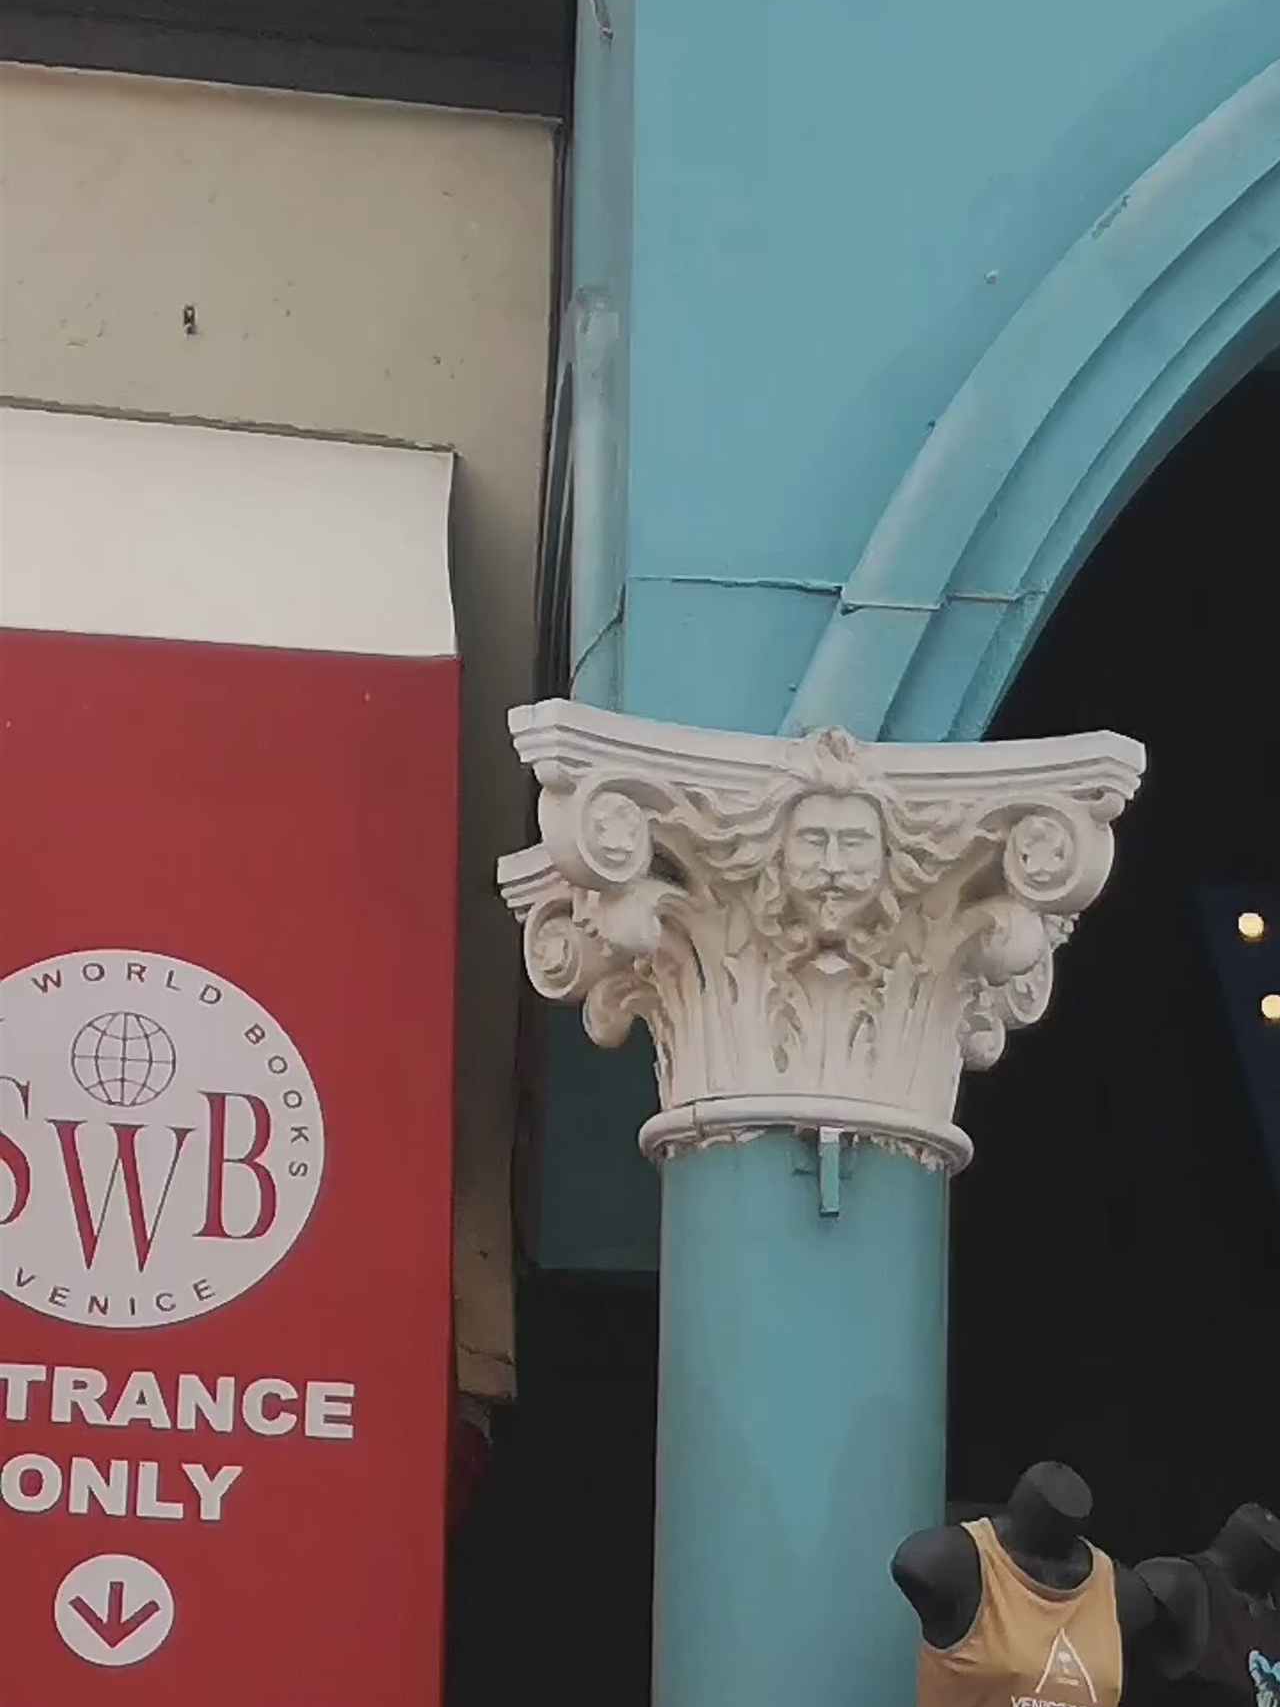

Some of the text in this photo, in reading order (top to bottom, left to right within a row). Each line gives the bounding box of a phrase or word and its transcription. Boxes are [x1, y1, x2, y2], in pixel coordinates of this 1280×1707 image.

[32, 961, 309, 1177] WORLD BOOKS
[15, 1266, 217, 1316] VENICE
[0, 1453, 244, 1521] ONLY
